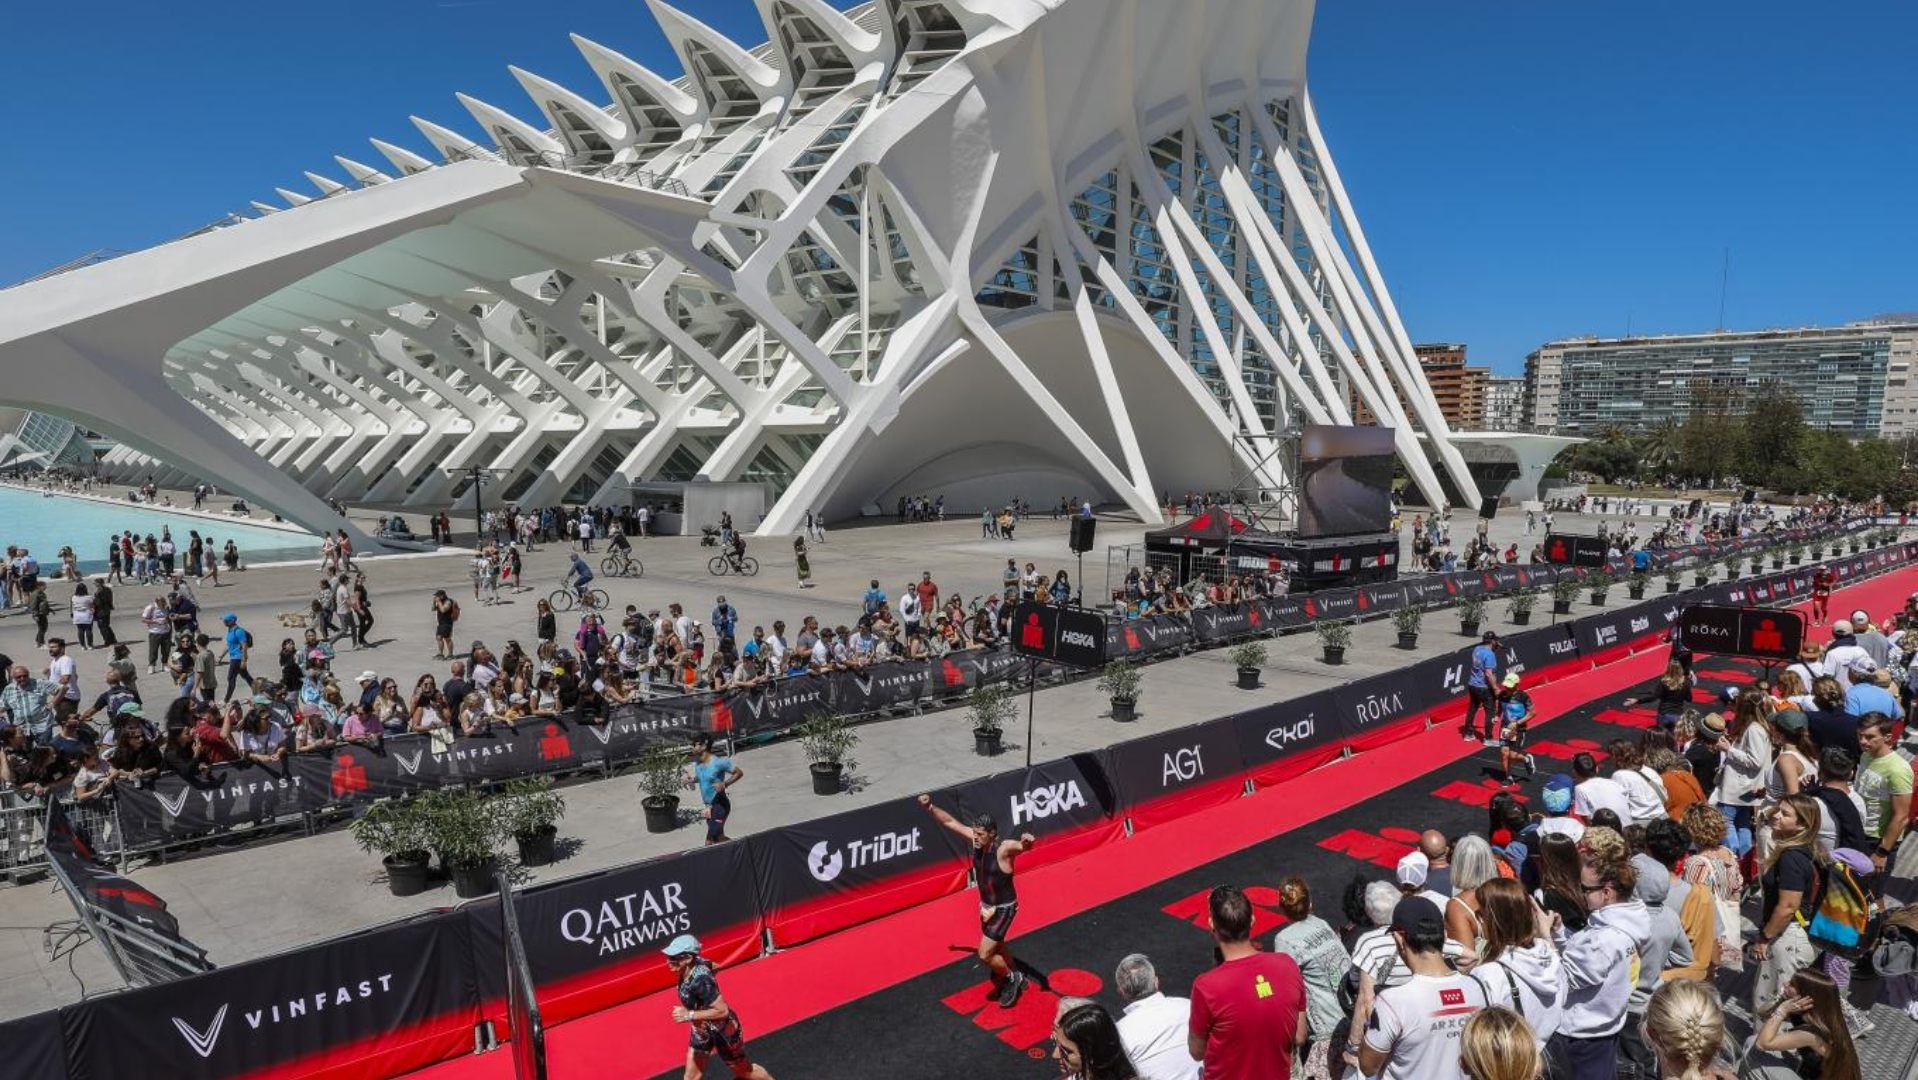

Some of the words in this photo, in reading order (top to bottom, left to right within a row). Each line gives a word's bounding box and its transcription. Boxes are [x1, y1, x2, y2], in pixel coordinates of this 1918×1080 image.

[1061, 630, 1095, 648] HOKA
[879, 670, 930, 687] VINFAST
[769, 691, 821, 709] VINFAST
[621, 716, 689, 734] VINFAST
[432, 743, 514, 764] VINFAST
[1163, 745, 1204, 787] AG1
[201, 776, 302, 802] VINFAST
[1010, 780, 1086, 826] HOKA
[847, 826, 921, 869] TriDot
[560, 882, 688, 945] QATAR
[598, 912, 691, 956] AIRWAYS
[245, 974, 392, 1030] VINFAST
